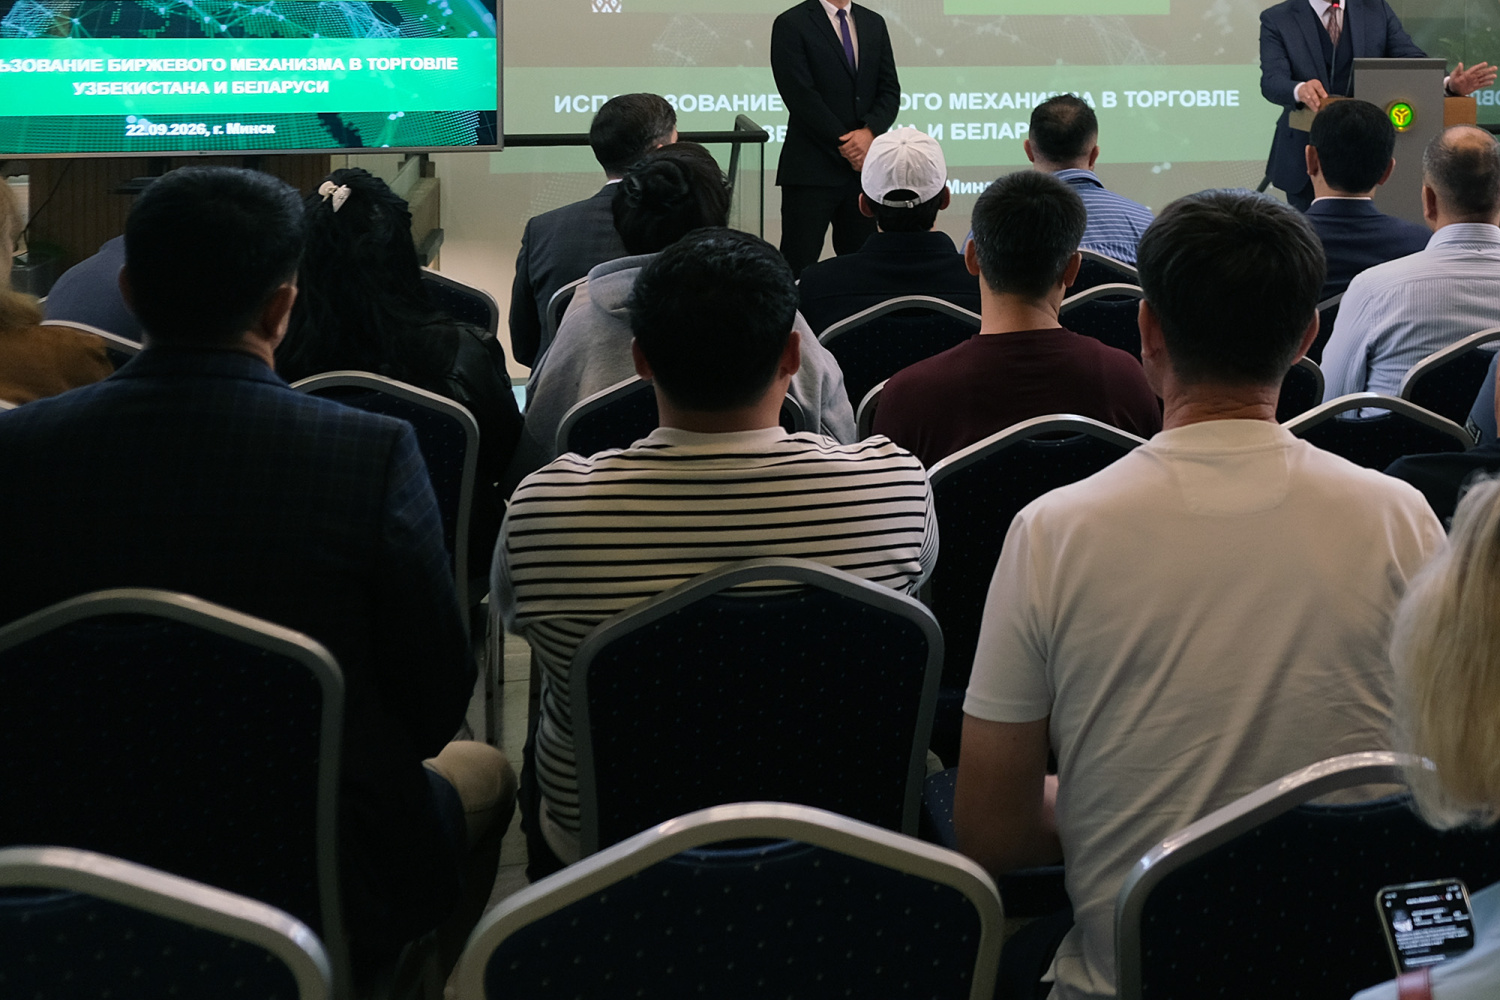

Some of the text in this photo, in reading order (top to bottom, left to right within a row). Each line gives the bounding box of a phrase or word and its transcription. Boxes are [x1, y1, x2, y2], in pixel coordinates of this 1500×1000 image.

[0, 57, 458, 73] ЬЗОВАНИЕ БИРЖЕВОГО МЕХАНИЗМА В ТОРГОВЛЕ
[73, 80, 329, 95] УЗБЕКИСТАНА И БЕЛАРУСИ
[1102, 91, 1118, 108] В
[1124, 89, 1240, 108] ТОРГОВЛЕ
[125, 122, 276, 137] 22.09.2026, г. Минск
[928, 123, 943, 140] И
[950, 122, 1029, 140] БЕЛАР
